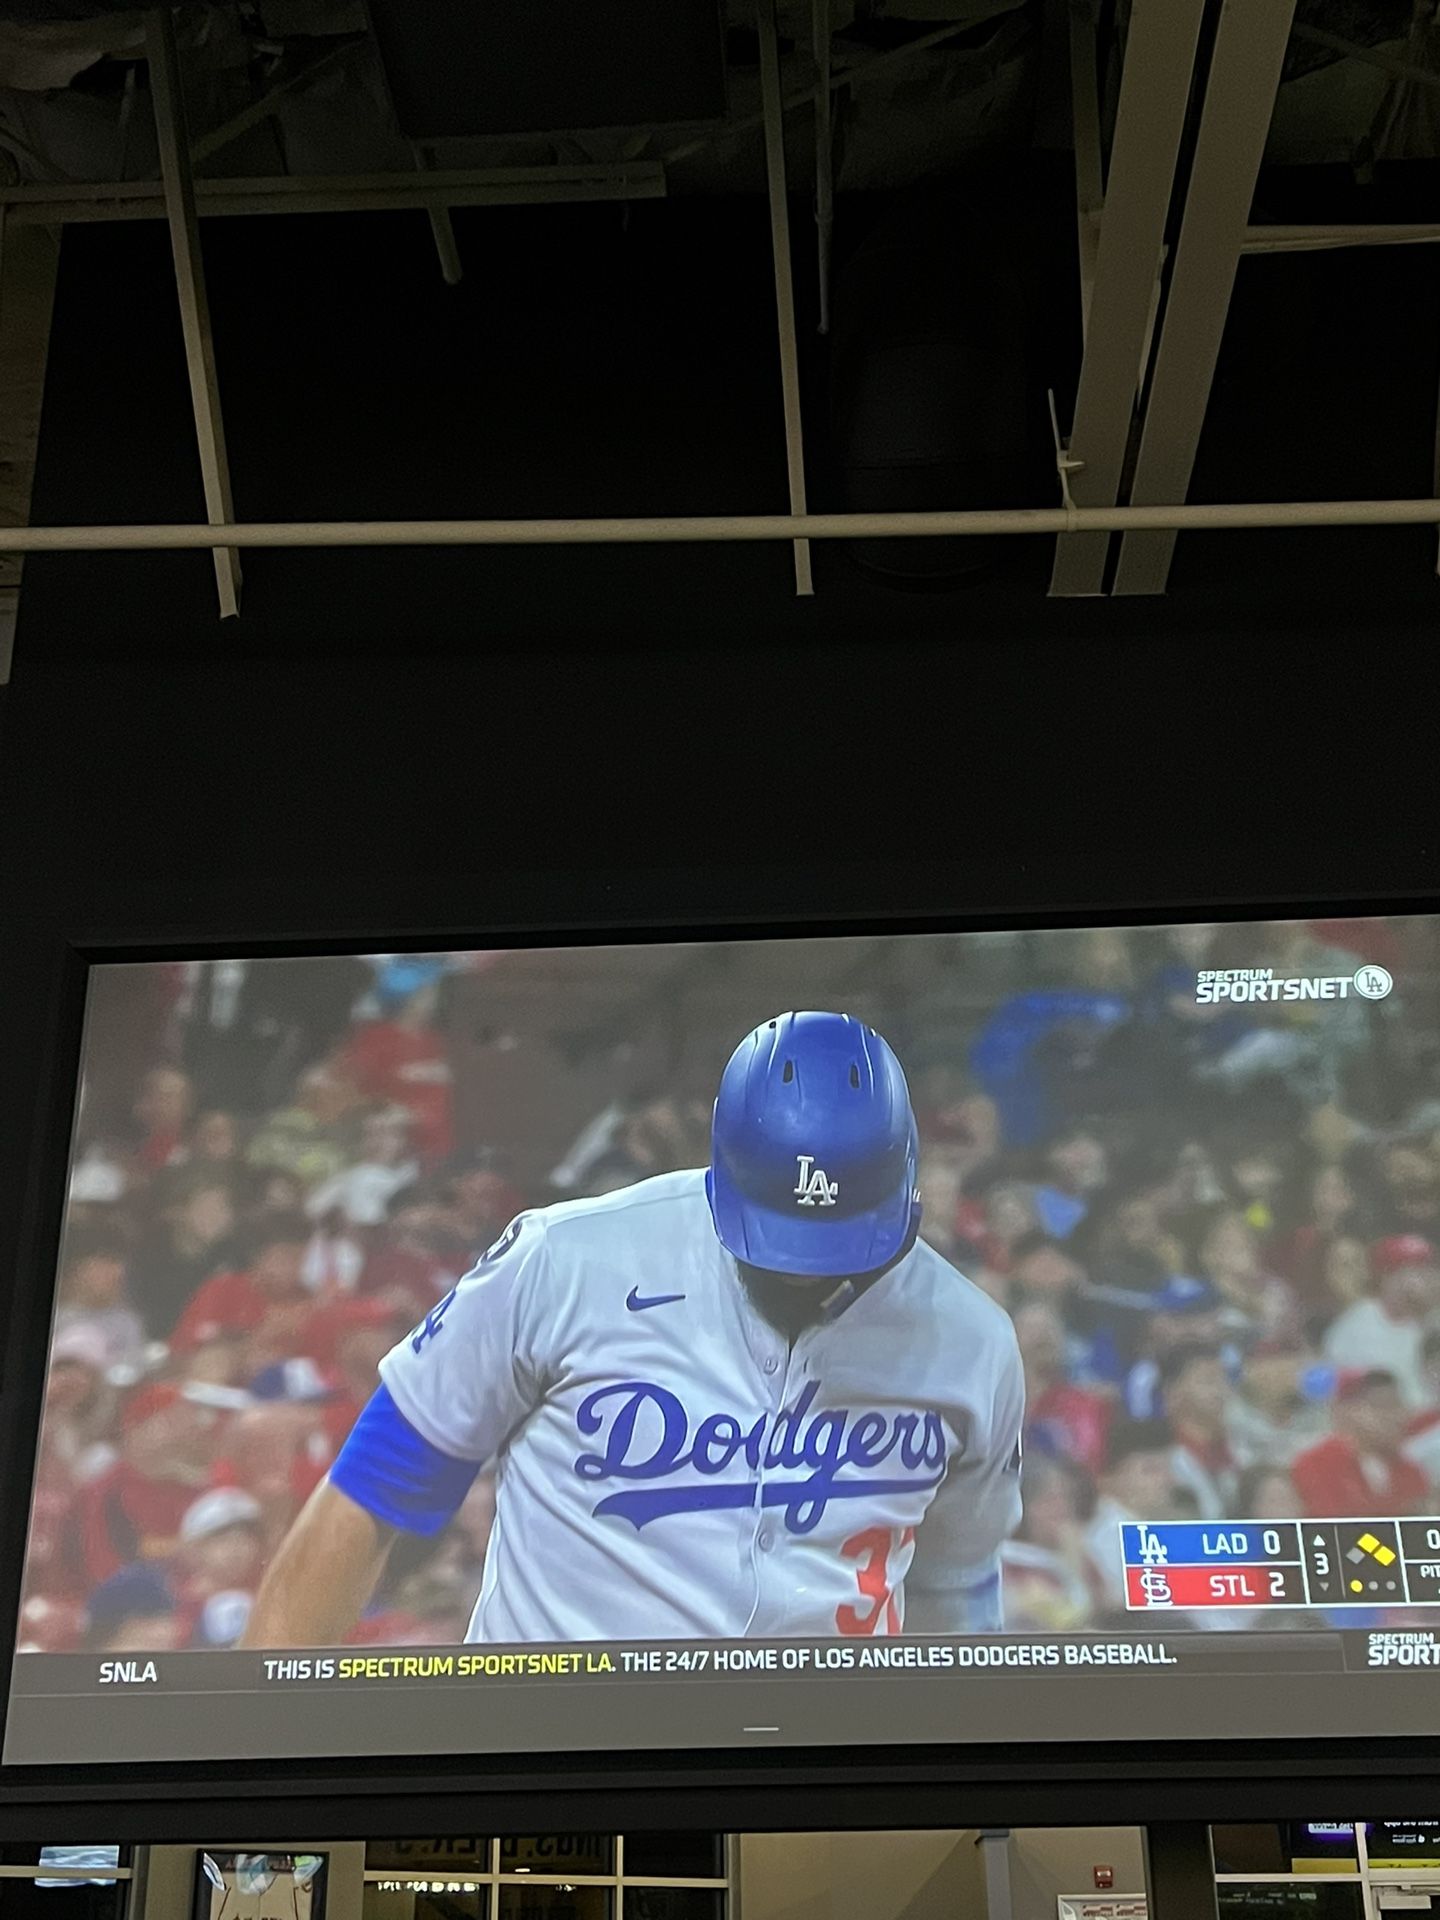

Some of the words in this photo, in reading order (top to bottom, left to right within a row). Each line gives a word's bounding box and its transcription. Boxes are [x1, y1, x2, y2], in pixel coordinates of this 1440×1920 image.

[1197, 968, 1273, 983] SPECTRUM
[1196, 977, 1353, 1003] SPORTSNET
[793, 1155, 839, 1206] LA
[574, 1381, 947, 1534] Dodgers
[1137, 1525, 1168, 1564] LA
[1203, 1532, 1248, 1555] LAD
[1263, 1530, 1281, 1554] 0
[1313, 1552, 1329, 1575] 3
[1209, 1574, 1256, 1597] STL
[1268, 1571, 1286, 1597] 2
[1368, 1632, 1434, 1645] SPECTRUM
[264, 1660, 311, 1680] THIS
[315, 1659, 335, 1679] IS
[338, 1656, 452, 1678] SPECTRUM
[457, 1653, 583, 1676] SPORTSNET
[586, 1653, 617, 1673] LA.
[620, 1652, 661, 1672] THE
[665, 1651, 709, 1671] 24/7
[714, 1649, 777, 1670] HOME
[782, 1648, 810, 1669] OF
[815, 1648, 855, 1668] LOS
[858, 1646, 954, 1667] ANGELES
[959, 1645, 1060, 1666] DODGERS
[1064, 1643, 1178, 1665] BASEBALL.
[1368, 1643, 1440, 1666] SPORT
[99, 1661, 158, 1683] SNLA
